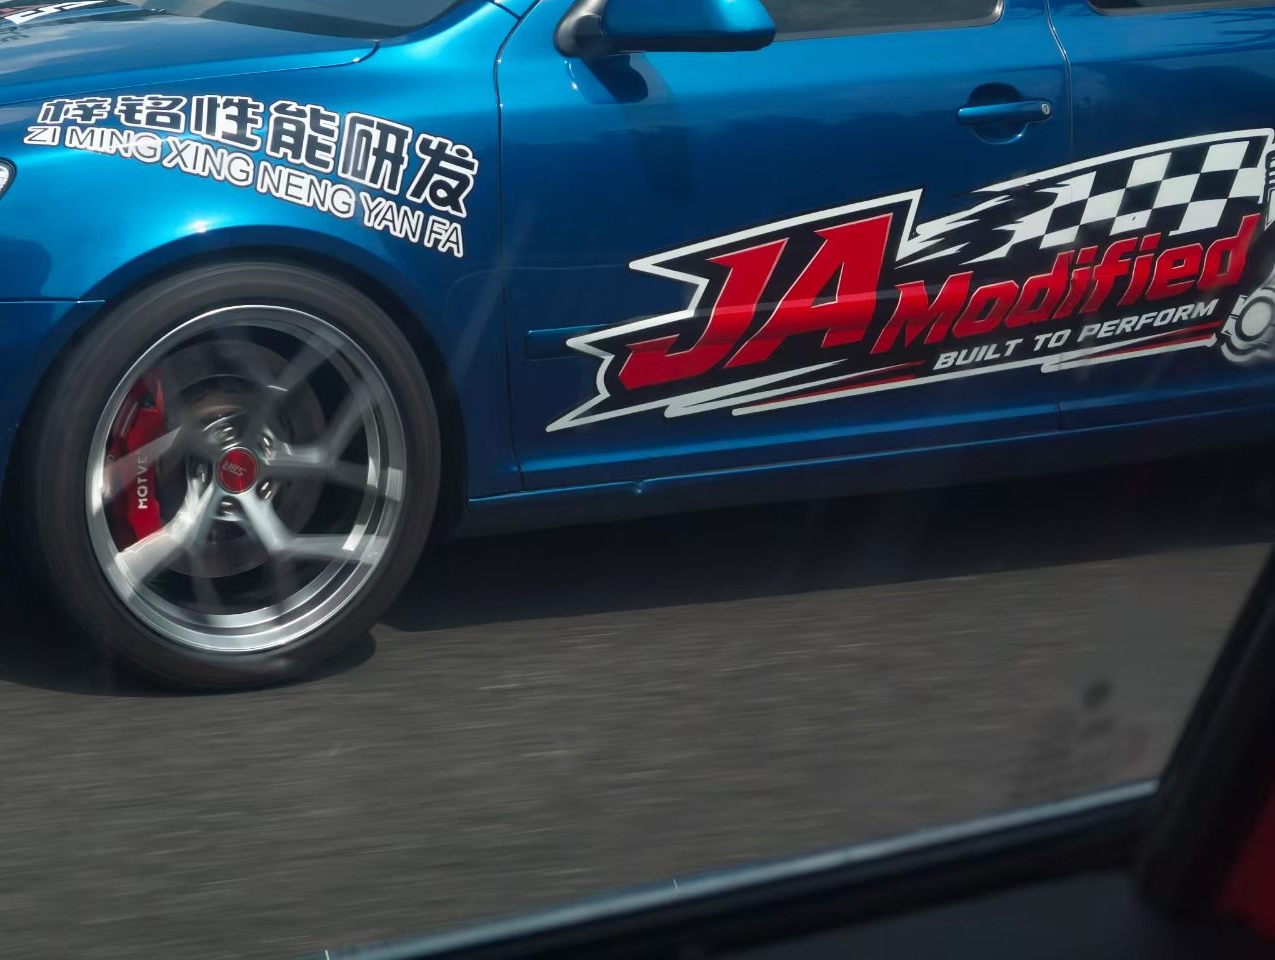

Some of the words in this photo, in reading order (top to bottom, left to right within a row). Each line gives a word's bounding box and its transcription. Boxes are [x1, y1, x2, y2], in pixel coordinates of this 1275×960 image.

[23, 125, 60, 147] ZI
[64, 126, 163, 166] MING
[162, 136, 255, 186] XING
[256, 159, 355, 220] NENG
[360, 193, 432, 246] YAN
[424, 215, 465, 259] FA
[37, 94, 478, 218] 梓铭性能研发
[618, 212, 895, 390] JA
[870, 213, 1262, 356] Modified
[932, 338, 1024, 372] BUILT
[1033, 327, 1073, 354] TO
[1076, 298, 1220, 343] PERFORM
